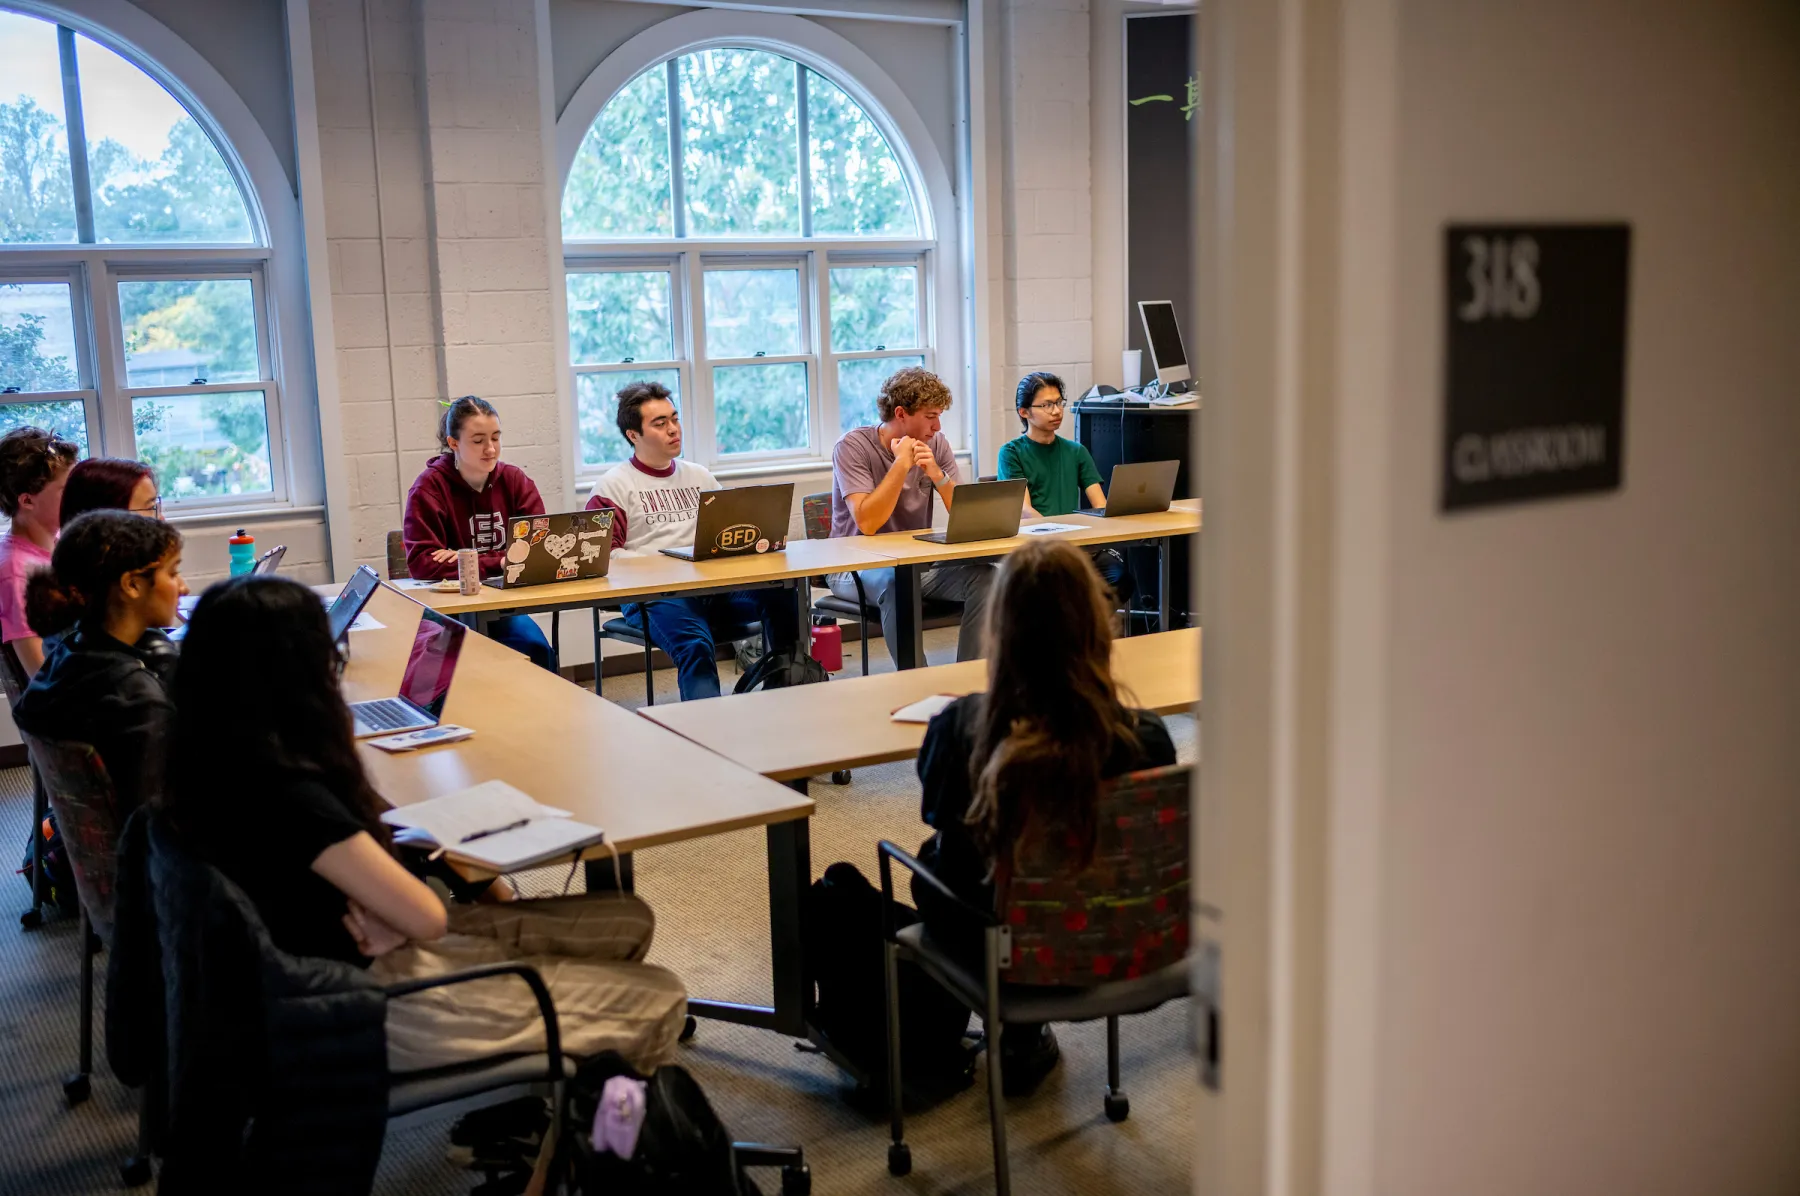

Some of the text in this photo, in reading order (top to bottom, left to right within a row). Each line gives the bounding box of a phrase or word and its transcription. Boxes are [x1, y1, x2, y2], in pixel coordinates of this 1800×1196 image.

[1458, 235, 1541, 321] 318
[645, 510, 698, 525] COLLE
[721, 529, 756, 546] BFD
